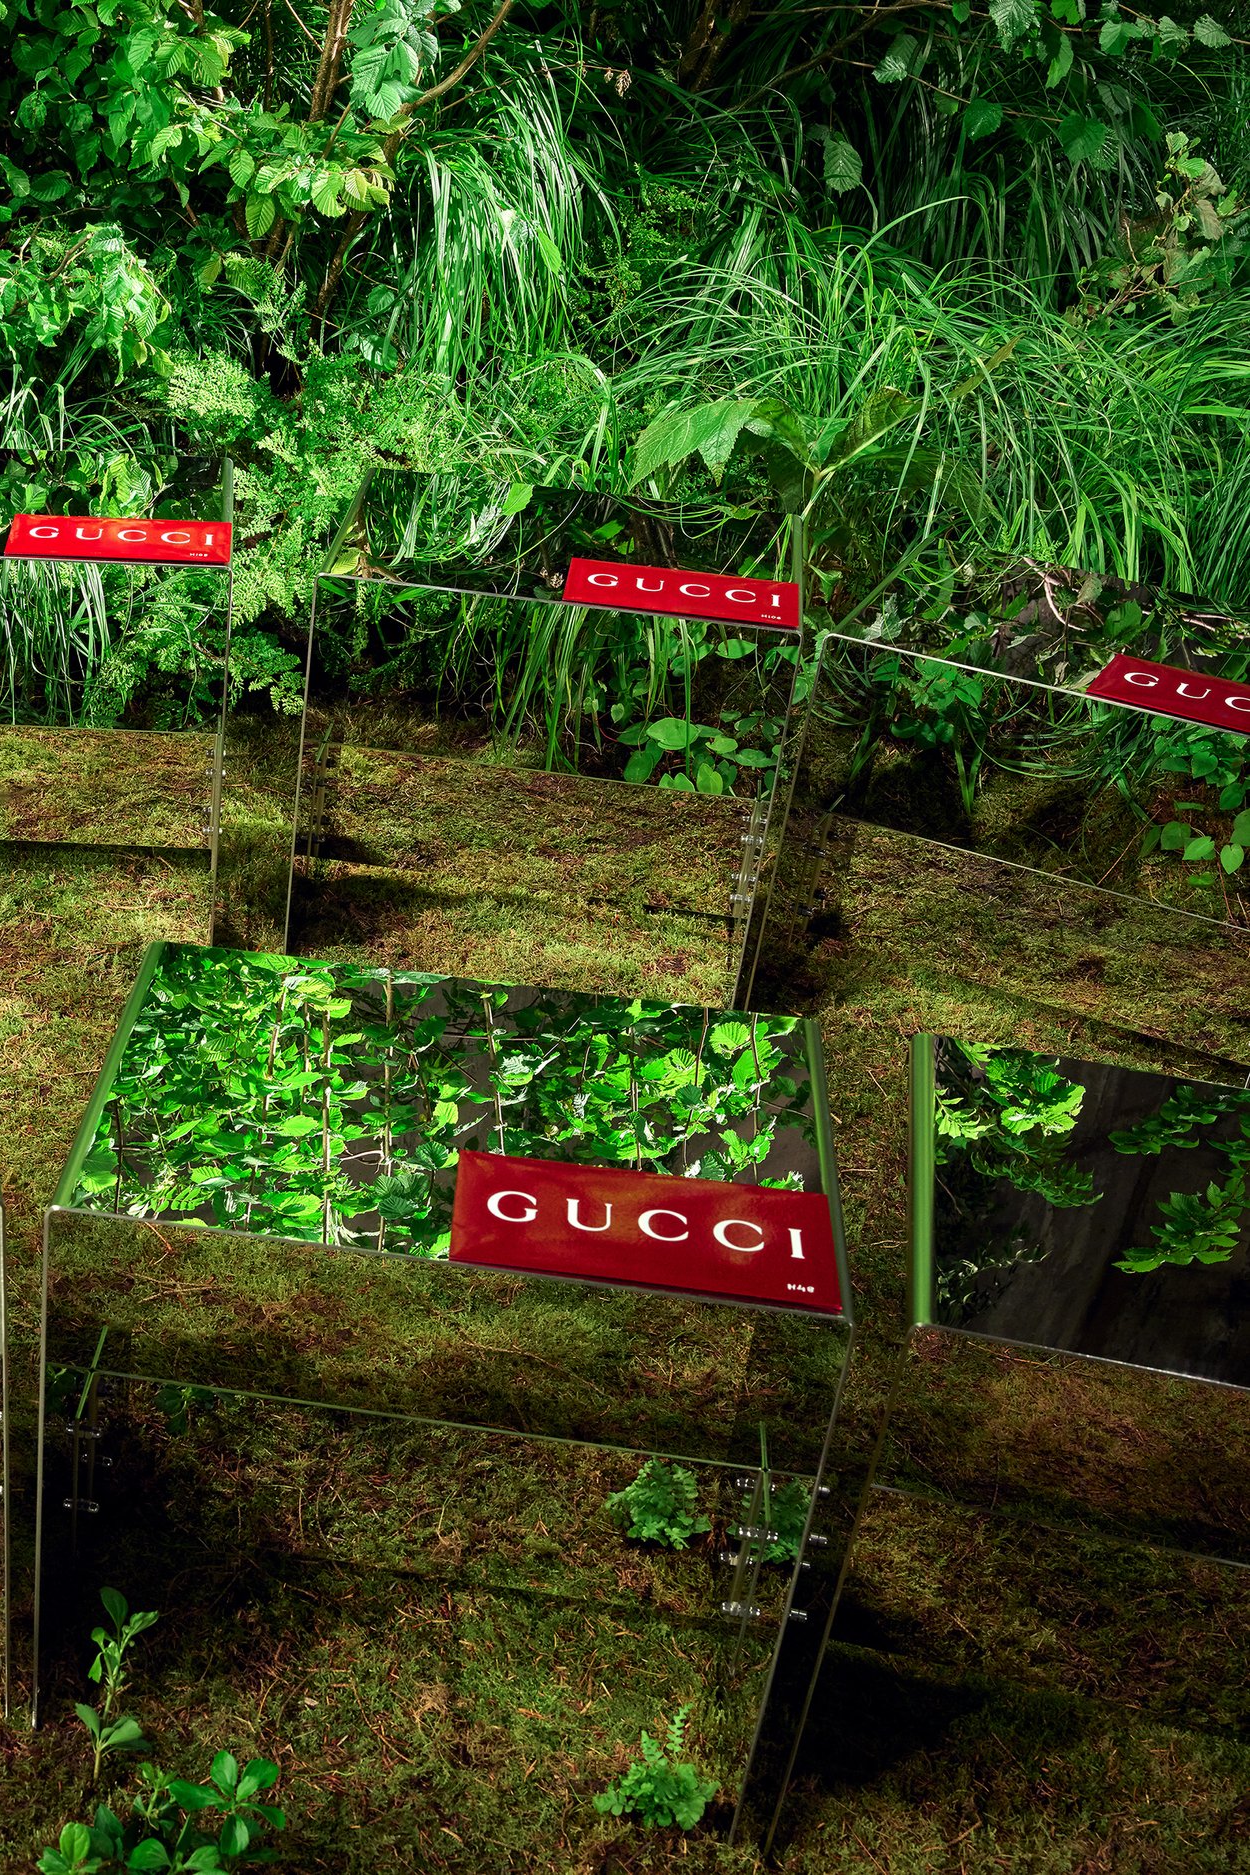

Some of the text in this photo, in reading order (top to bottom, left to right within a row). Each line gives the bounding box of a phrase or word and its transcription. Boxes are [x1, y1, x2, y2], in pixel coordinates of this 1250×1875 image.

[28, 526, 214, 546] GUCCI
[587, 573, 782, 608] GUCCI
[486, 1190, 806, 1260] GUCCI
